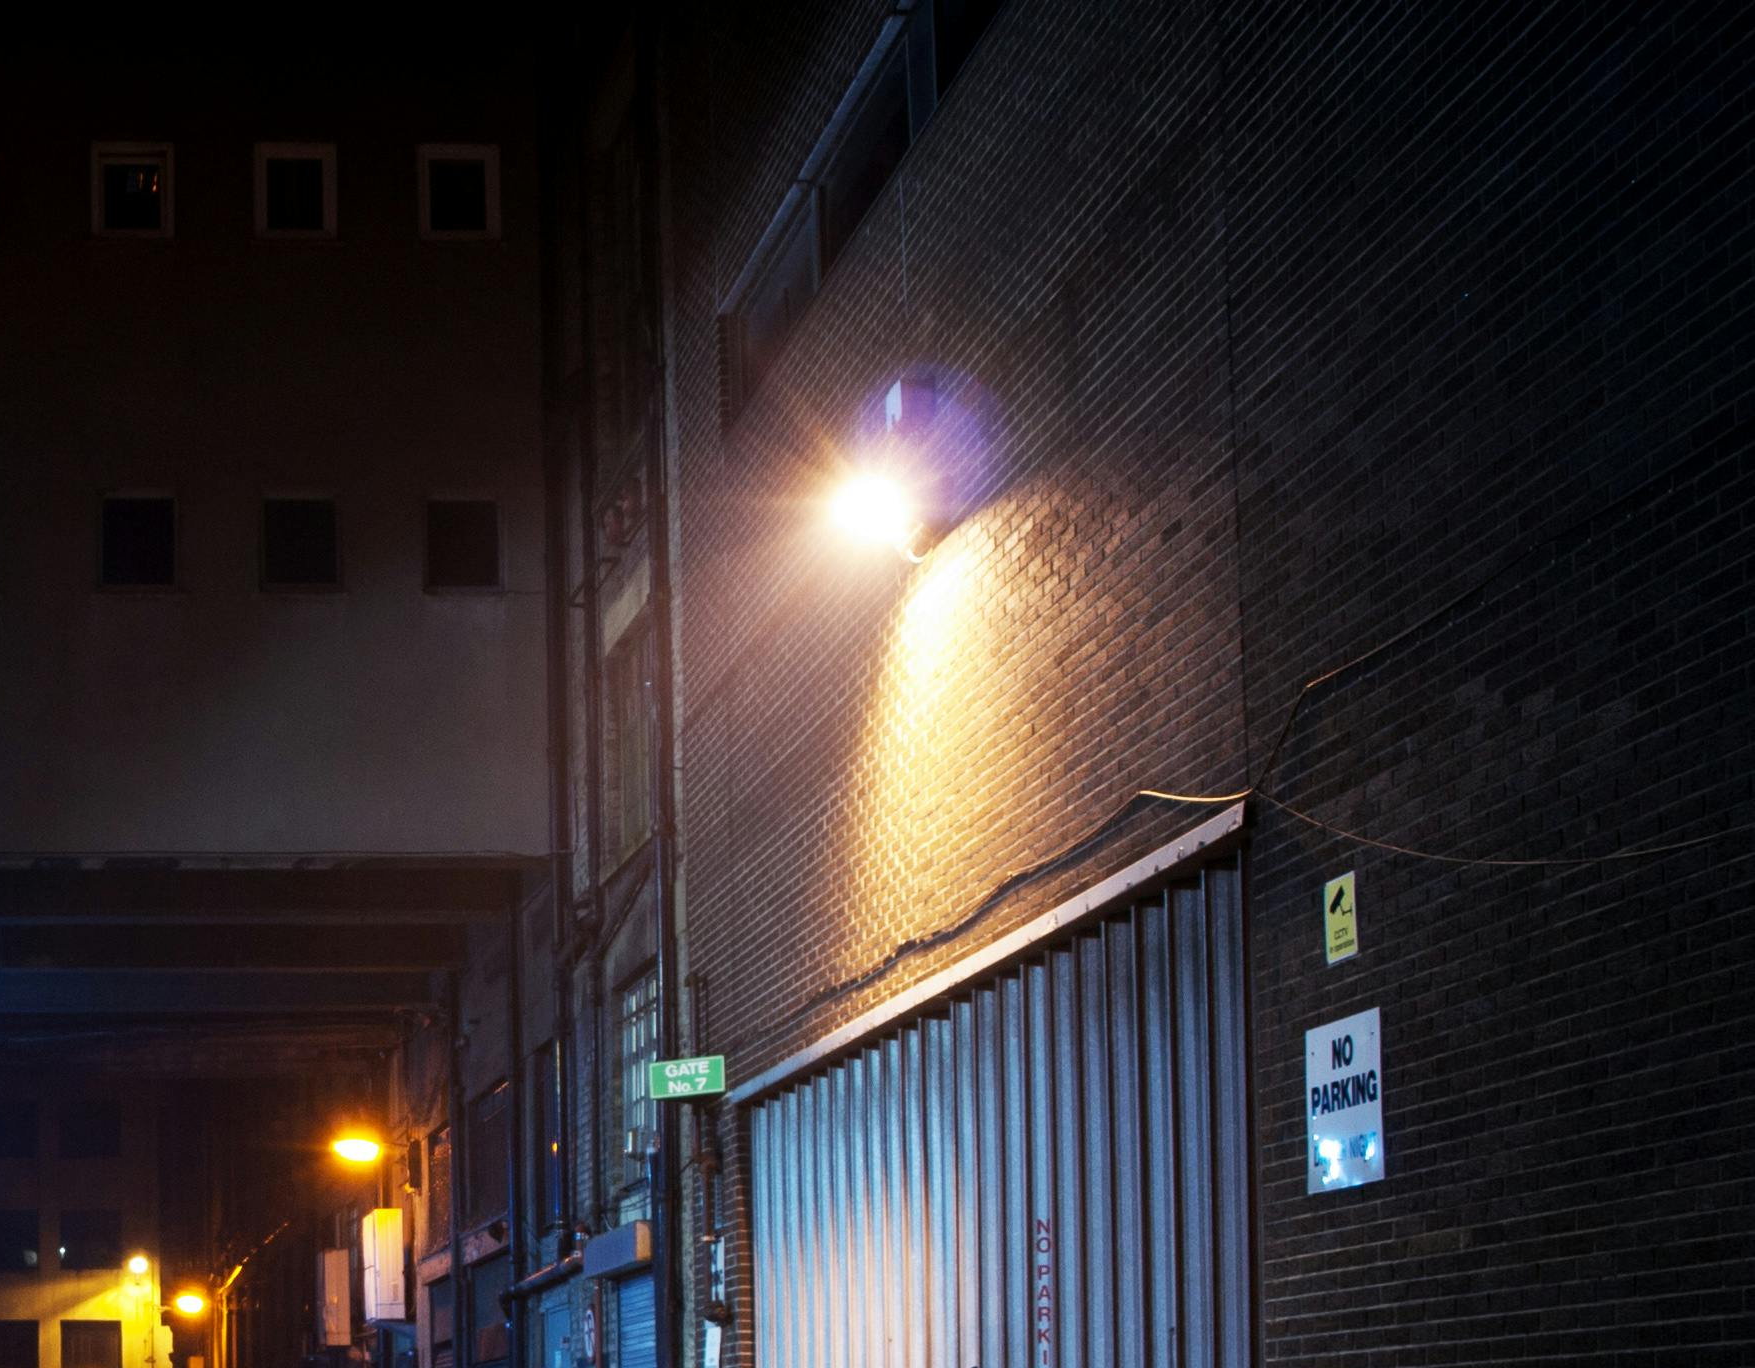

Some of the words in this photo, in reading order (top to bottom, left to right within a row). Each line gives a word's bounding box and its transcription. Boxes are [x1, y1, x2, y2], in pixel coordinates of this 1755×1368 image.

[665, 1061, 710, 1078] GATE
[1331, 1034, 1353, 1070] NO
[695, 1077, 707, 1091] 7
[1311, 1069, 1379, 1116] PARKING
[1036, 1218, 1051, 1254] NO
